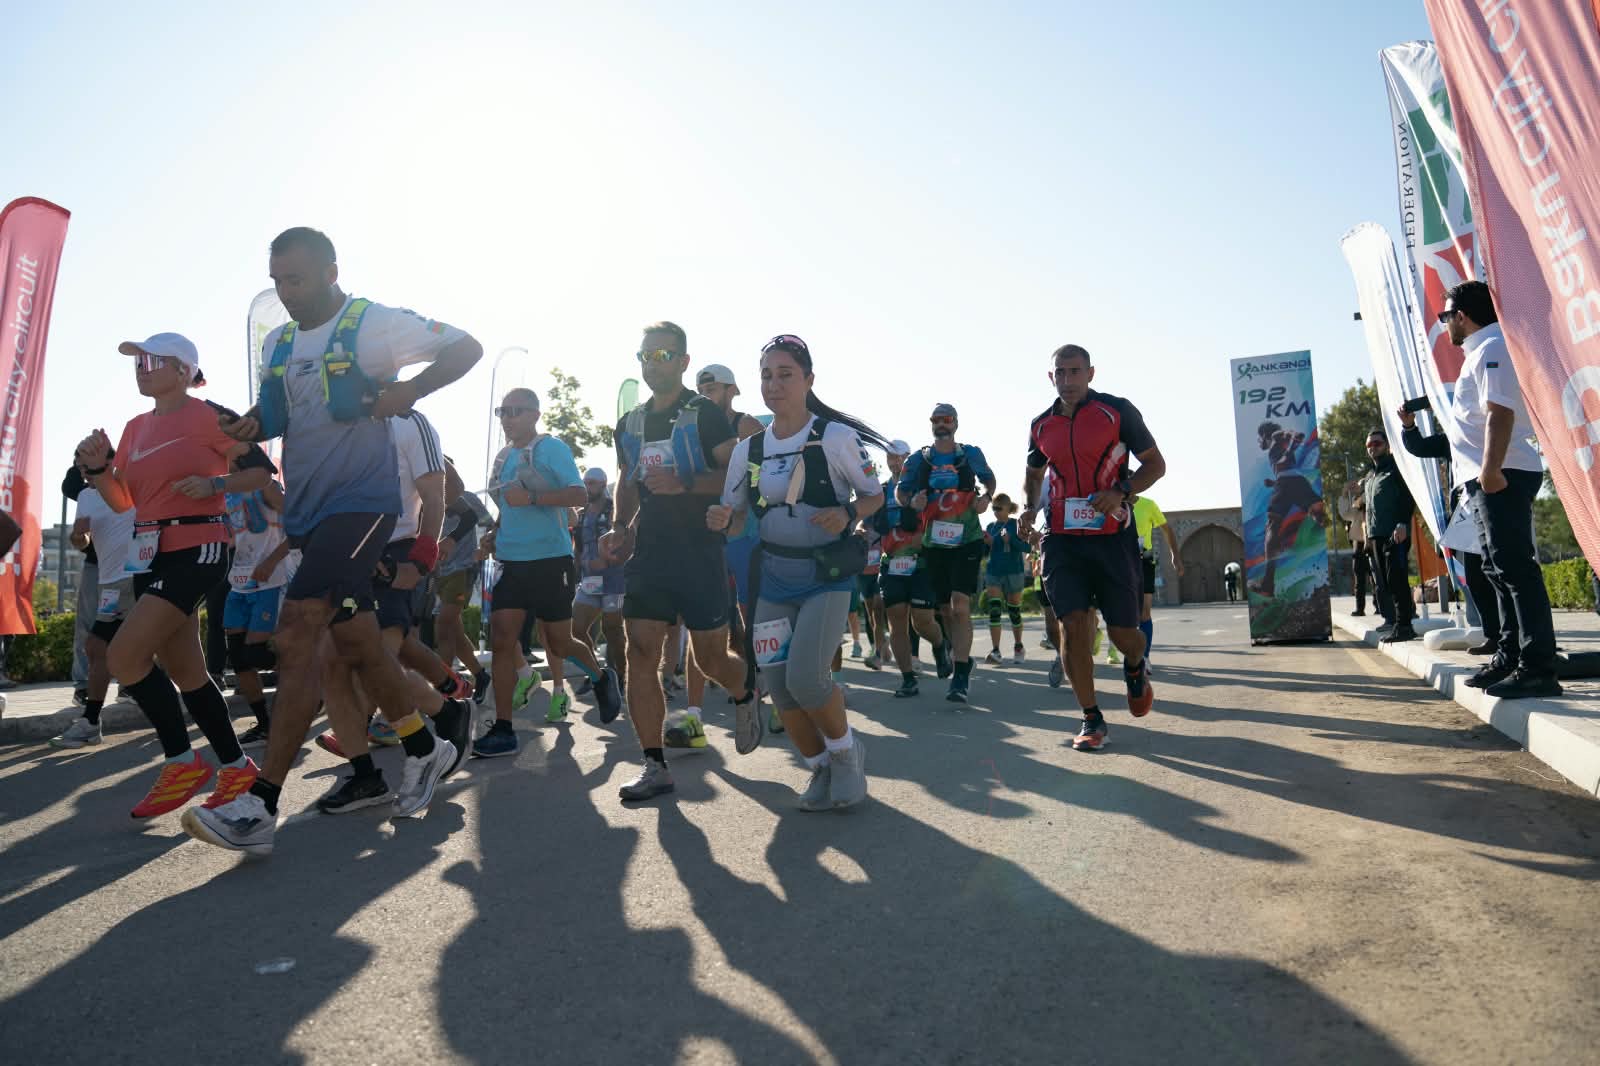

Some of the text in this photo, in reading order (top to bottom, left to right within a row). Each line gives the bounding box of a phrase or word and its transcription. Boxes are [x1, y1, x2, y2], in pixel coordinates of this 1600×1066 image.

[9, 254, 38, 354] circuit
[5, 356, 27, 419] city
[1239, 386, 1287, 405] 192
[1265, 400, 1311, 419] KM
[1073, 508, 1096, 520] 053
[938, 529, 955, 539] 012
[755, 637, 780, 654] 070
